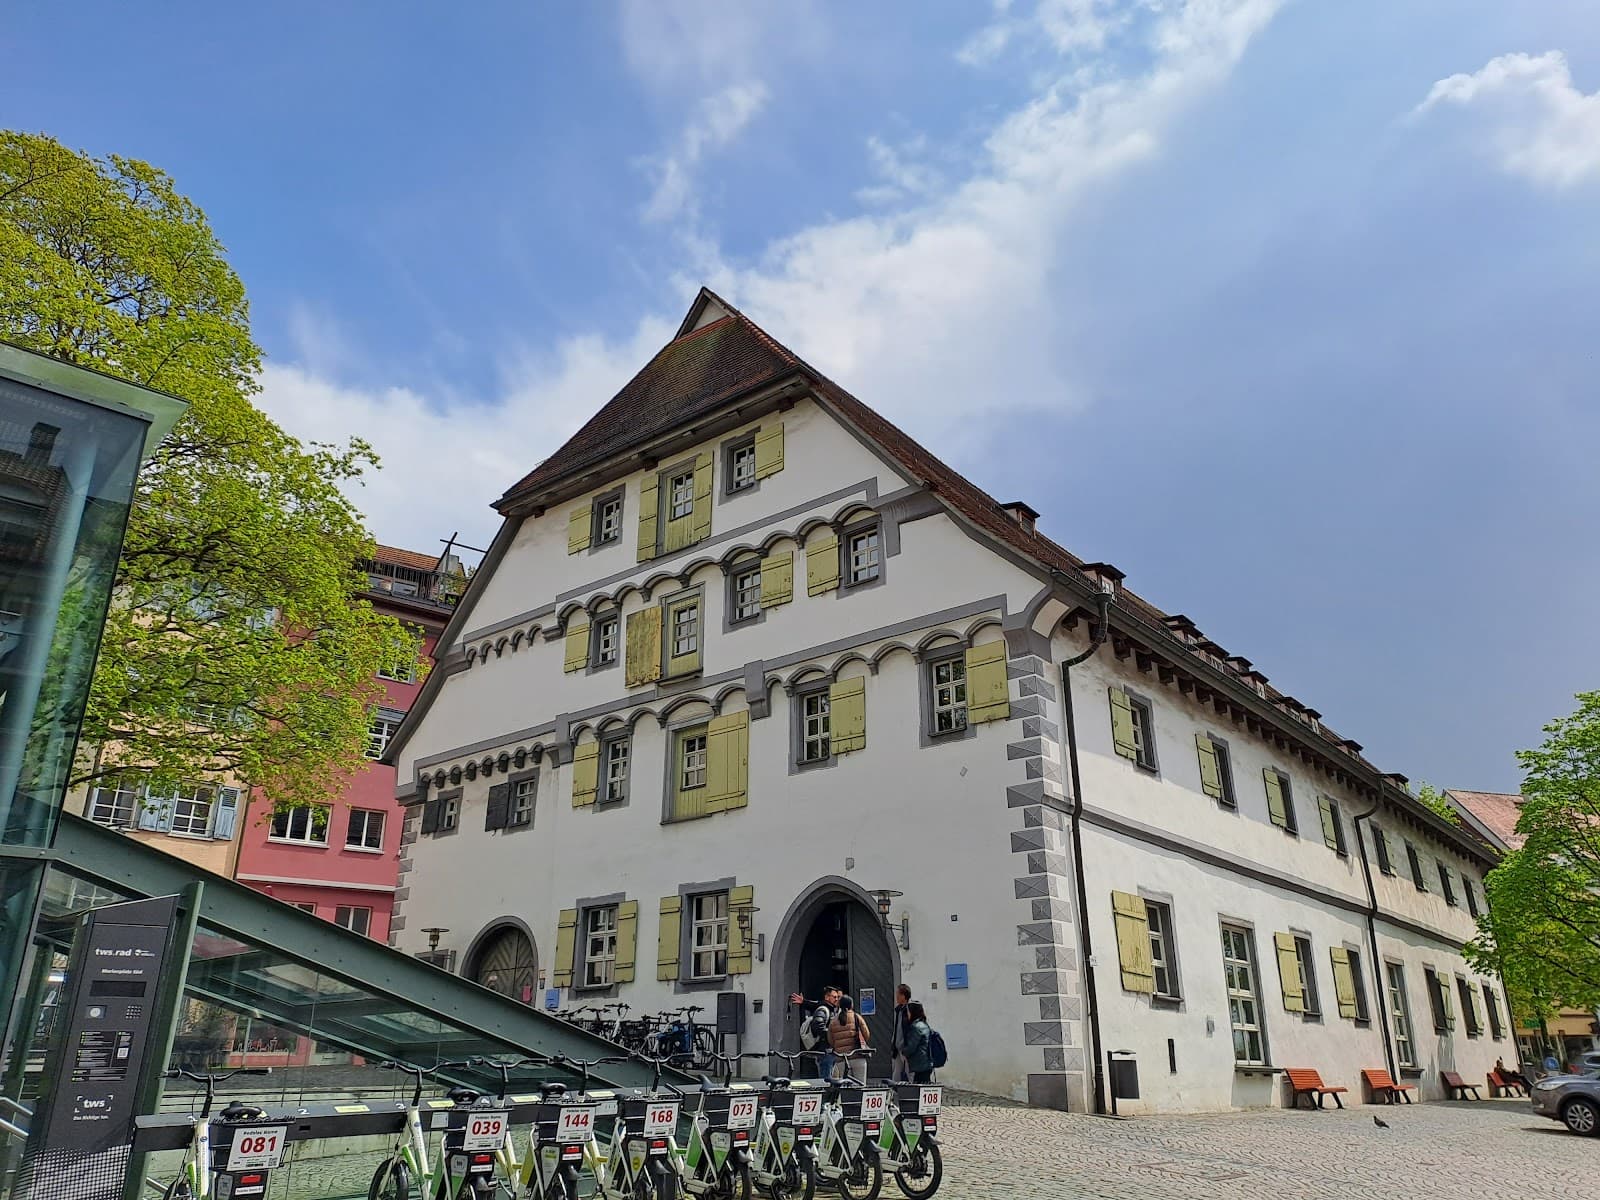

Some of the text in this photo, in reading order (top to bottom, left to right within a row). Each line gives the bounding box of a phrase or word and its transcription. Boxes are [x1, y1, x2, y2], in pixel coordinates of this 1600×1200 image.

[95, 948, 132, 957] tws.rad
[83, 1099, 105, 1108] tws
[865, 1097, 883, 1109] 180
[922, 1093, 938, 1105] 108
[732, 1104, 753, 1116] 073
[798, 1100, 817, 1113] 157
[564, 1113, 589, 1128] 144
[650, 1109, 673, 1124] 168
[471, 1120, 501, 1136] 039
[240, 1135, 277, 1154] 081
